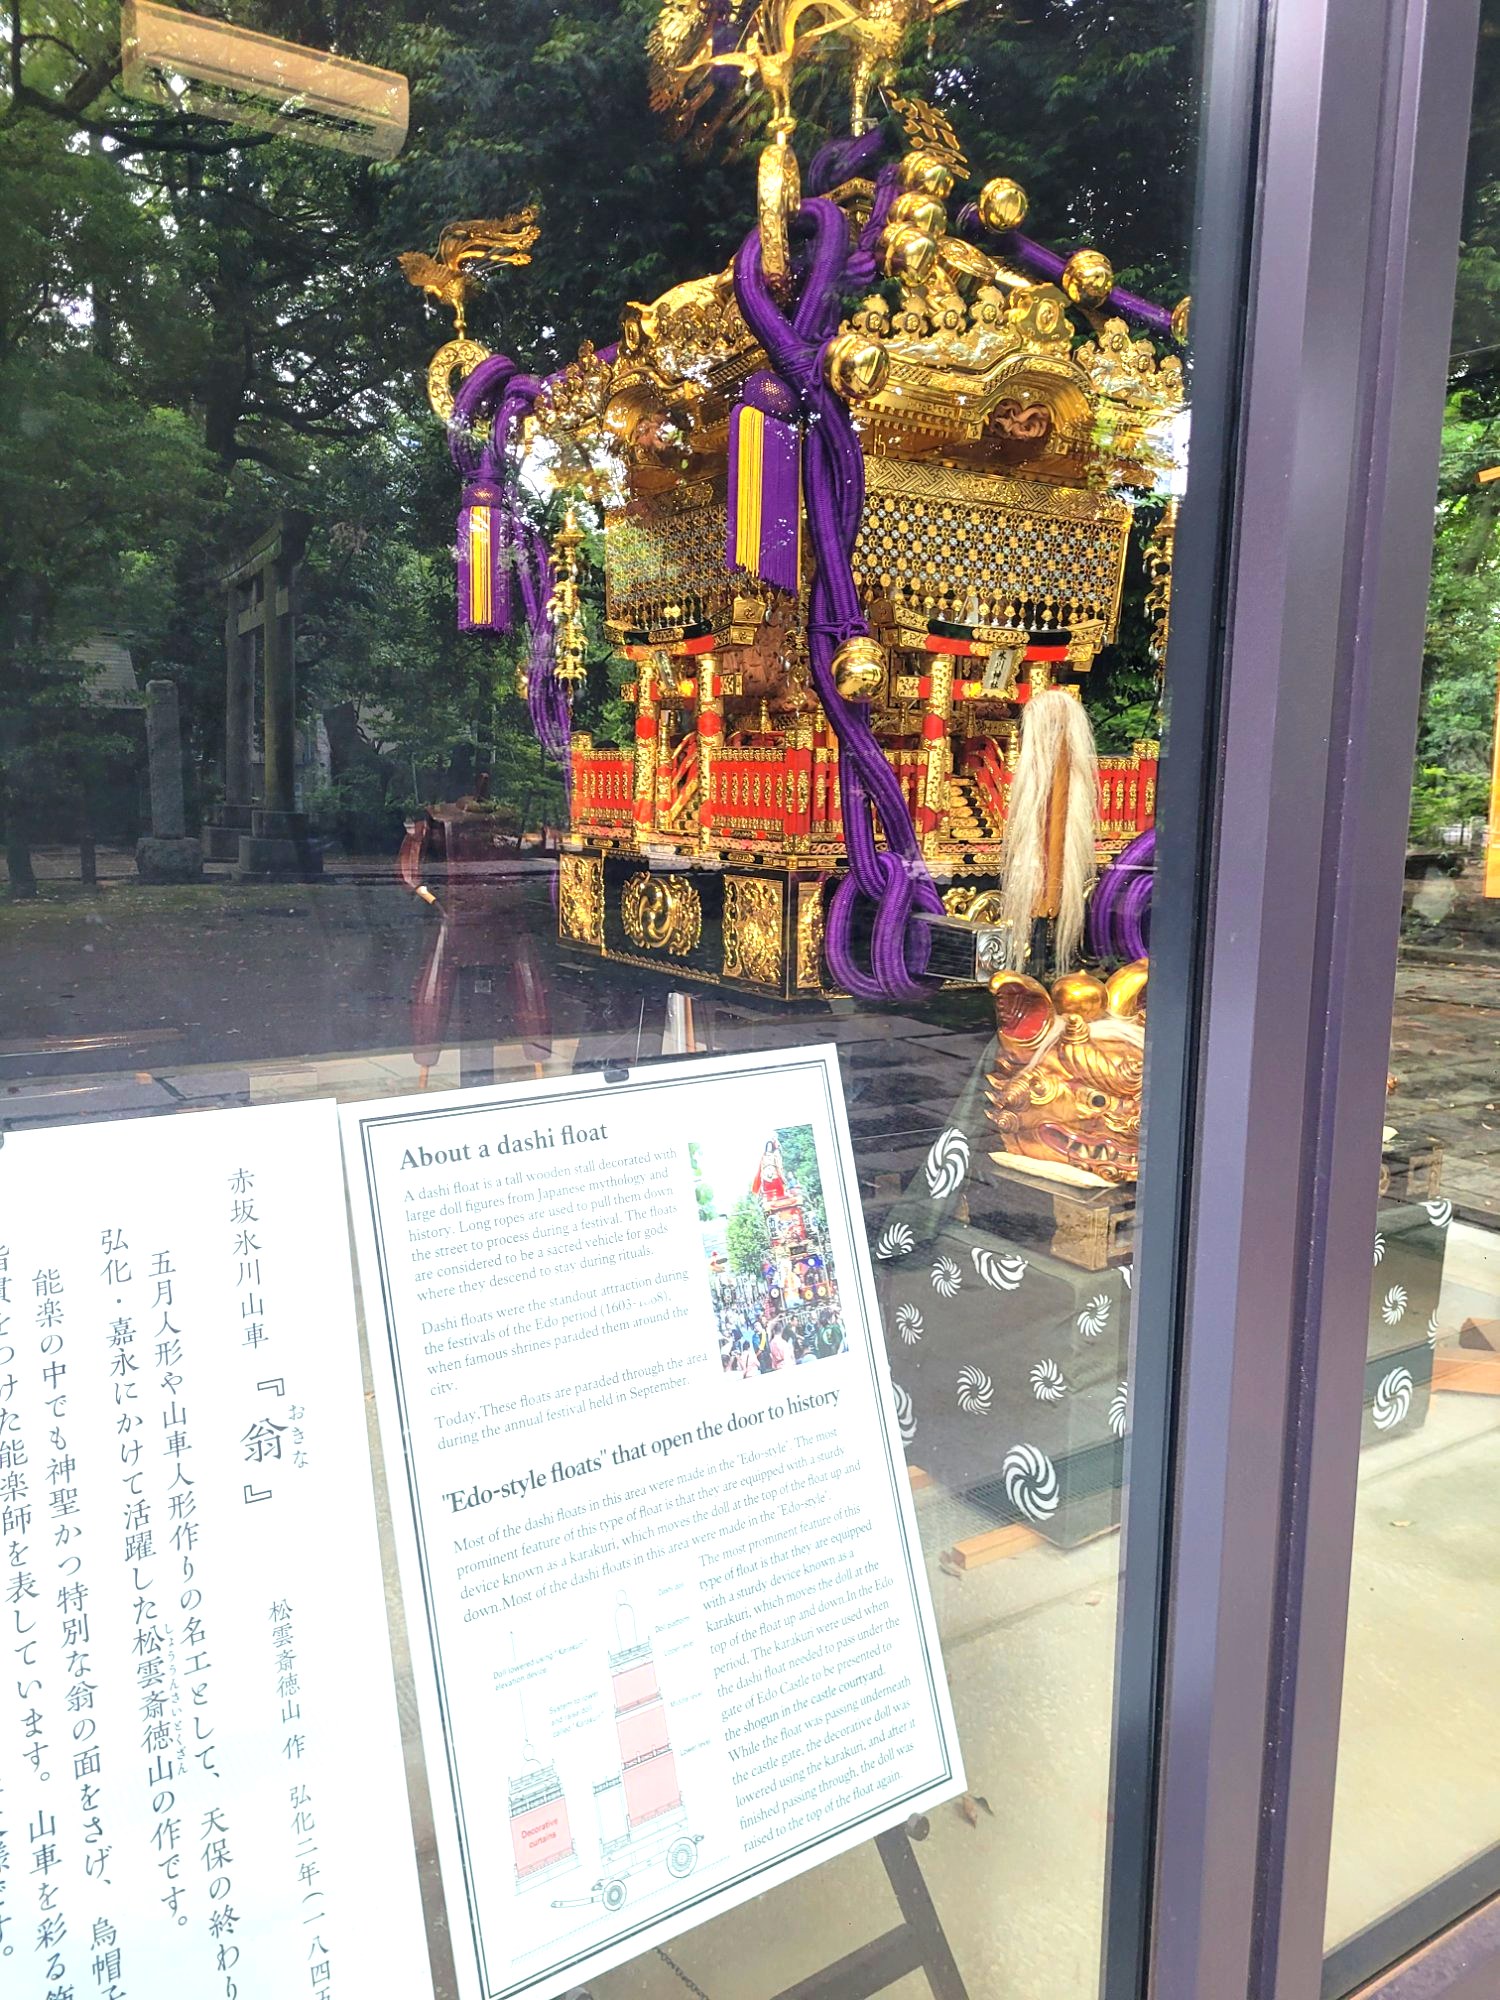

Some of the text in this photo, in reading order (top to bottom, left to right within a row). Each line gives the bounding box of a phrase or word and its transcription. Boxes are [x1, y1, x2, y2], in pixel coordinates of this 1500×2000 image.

[399, 1123, 609, 1171] About a dashi float
[404, 1189, 415, 1203] A
[418, 1183, 450, 1200] dashi
[453, 1180, 481, 1195] float
[482, 1177, 493, 1190] is
[495, 1178, 502, 1188] a
[504, 1171, 523, 1186] tall
[573, 1159, 596, 1175] stall
[598, 1151, 652, 1171] decorated
[405, 1166, 669, 1223] large doll figures from Japanese mythology and
[411, 1248, 432, 1262] the
[434, 1243, 469, 1258] street
[470, 1240, 484, 1251] to
[486, 1232, 530, 1252] process
[532, 1224, 570, 1239] during
[572, 1223, 579, 1232] a
[624, 1208, 647, 1222] The
[649, 1205, 678, 1217] floats
[458, 1219, 492, 1233] Long
[493, 1213, 525, 1228] ropes
[527, 1210, 545, 1221] are
[548, 1201, 575, 1217] used
[576, 1202, 588, 1212] to
[590, 1194, 612, 1213] pull
[613, 1192, 642, 1205] them
[643, 1187, 674, 1200] down
[227, 1167, 269, 1350] 赤坂氷川山車
[414, 1222, 669, 1283] are considered to be a sacred vehicle for gods
[416, 1286, 456, 1302] where
[458, 1280, 486, 1294] they
[489, 1266, 537, 1288] descend
[539, 1267, 552, 1277] to
[554, 1261, 577, 1275] stay
[579, 1253, 617, 1269] during
[421, 1269, 690, 1336] Dashi floats were the standout attraction during
[424, 1341, 445, 1356] the
[447, 1328, 496, 1350] festivals
[498, 1324, 510, 1339] of
[513, 1321, 532, 1336] the
[534, 1315, 559, 1331] Edo
[561, 1305, 598, 1328] period
[426, 1305, 689, 1375] when famous shrines paraded them around the
[519, 1392, 552, 1408] floats
[554, 1387, 572, 1399] are
[574, 1371, 620, 1397] paraded
[621, 1360, 665, 1382] through
[666, 1357, 684, 1370] the
[686, 1352, 708, 1366] area
[288, 1404, 310, 1470] おきな
[437, 1431, 480, 1451] during
[481, 1424, 501, 1439] the
[504, 1410, 544, 1433] annual
[546, 1399, 587, 1422] festival
[588, 1392, 614, 1411] held
[615, 1391, 627, 1403] in
[611, 1441, 648, 1466] that
[650, 1431, 694, 1457] open
[695, 1420, 724, 1441] the
[726, 1410, 765, 1432] door
[767, 1405, 785, 1421] to
[786, 1389, 840, 1415] history
[453, 1535, 486, 1554] Most
[488, 1526, 500, 1543] of
[502, 1523, 522, 1539] the
[524, 1511, 555, 1532] dashi
[556, 1504, 587, 1522] floats
[588, 1499, 601, 1512] in
[602, 1491, 623, 1508] this
[624, 1487, 647, 1501] area
[648, 1478, 675, 1492] were
[676, 1466, 705, 1485] made
[706, 1463, 718, 1476] in
[718, 1458, 735, 1472] the
[793, 1434, 814, 1449] The
[815, 1428, 838, 1443] most
[750, 1645, 772, 1661] The
[773, 1626, 815, 1653] karakuri
[815, 1619, 840, 1635] were
[840, 1607, 863, 1626] used
[863, 1600, 890, 1616] when
[724, 1727, 742, 1742] the
[743, 1711, 780, 1734] shogun
[780, 1705, 792, 1718] in
[792, 1698, 809, 1713] the
[810, 1685, 838, 1705] castle
[727, 1674, 912, 1762] While the float was passing underneath
[282, 1733, 307, 1760] 作
[521, 1818, 559, 1840] Decorative
